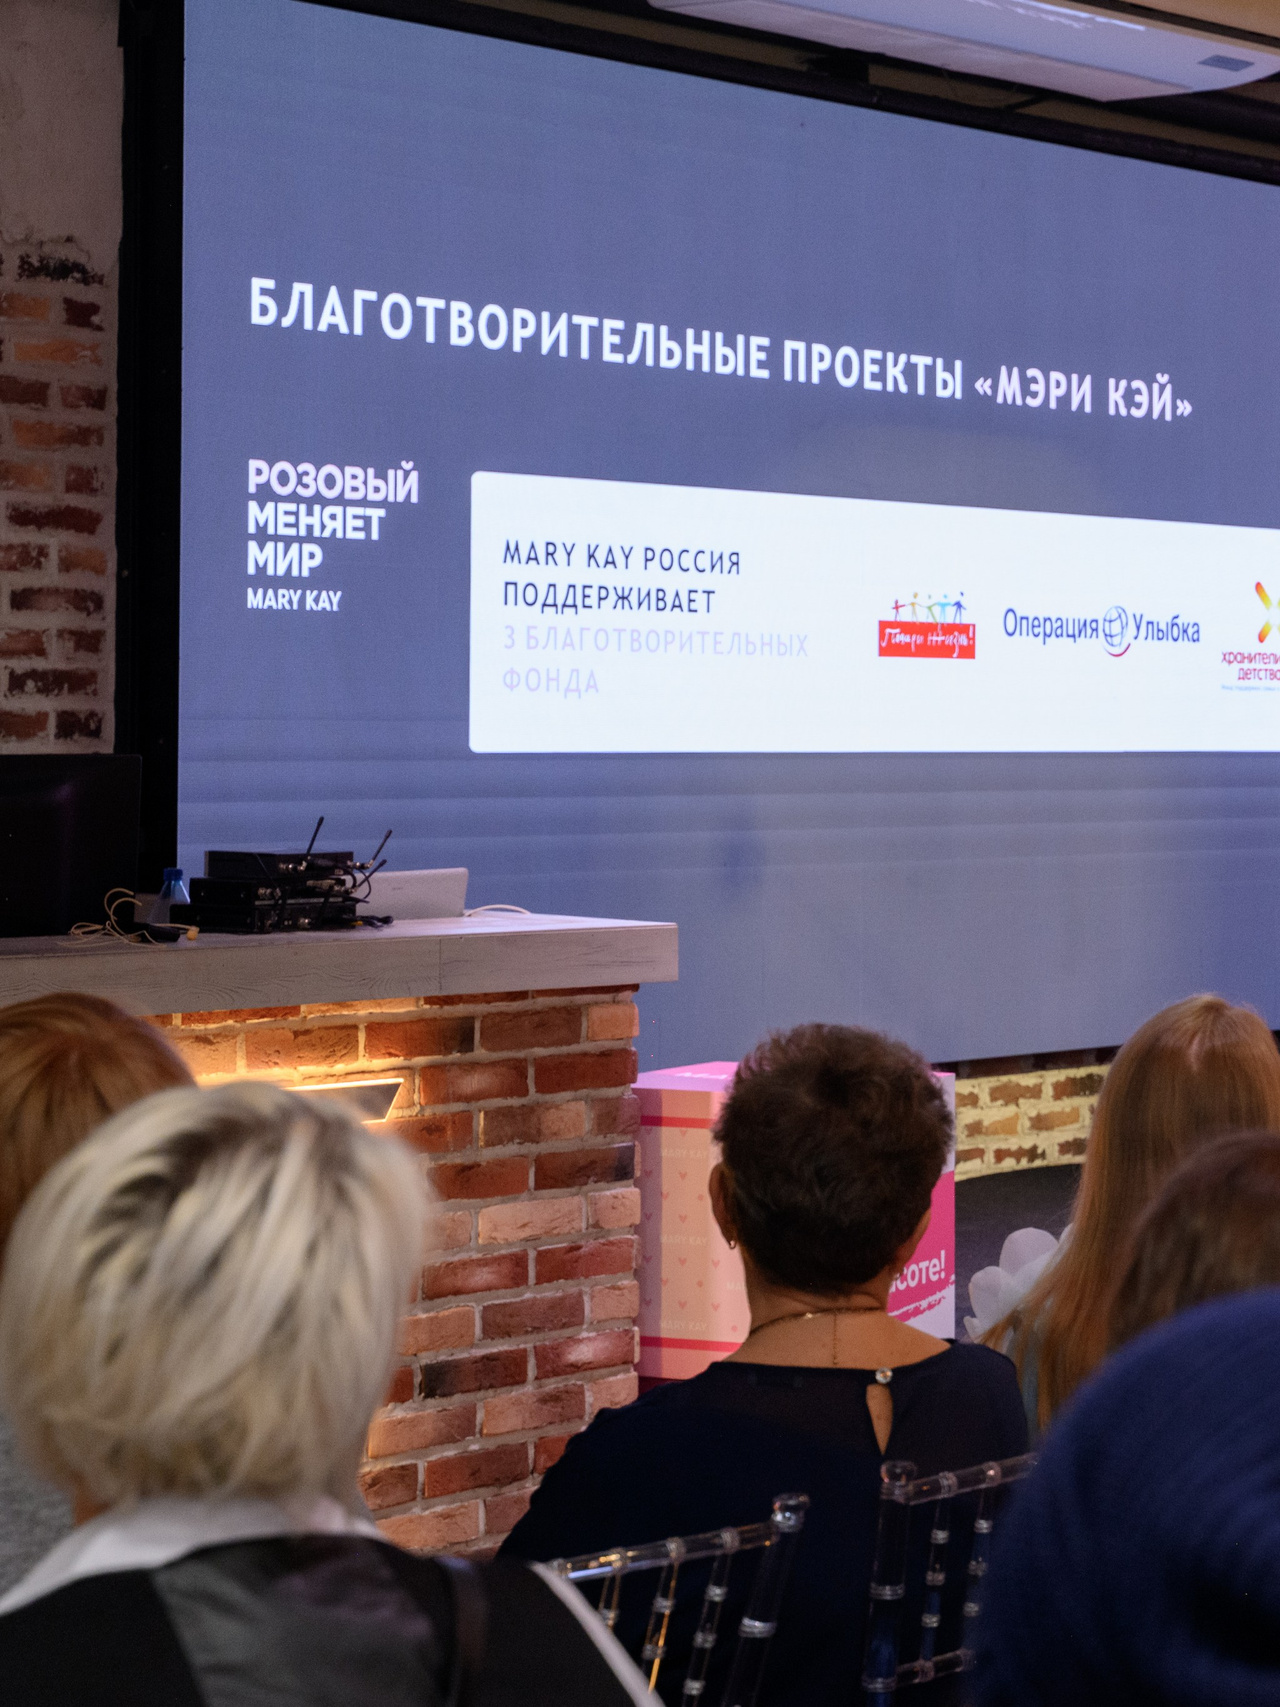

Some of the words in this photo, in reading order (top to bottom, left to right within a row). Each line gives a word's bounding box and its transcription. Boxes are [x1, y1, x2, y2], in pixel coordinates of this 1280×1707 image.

[250, 276, 772, 381] БЛАГОТВОРИТЕЛЬНЫЕ
[783, 340, 964, 401] ПРОЕКТЫ
[974, 365, 1094, 414] «МЭРИ
[1108, 373, 1194, 422] КЭЙ»
[248, 459, 420, 505] РОЗОВЫЙ
[248, 502, 386, 540] МЕНЯЕТ
[247, 541, 323, 578] МИР
[503, 540, 577, 568] MARY
[587, 544, 635, 572] KAY
[643, 547, 741, 576] РОССИЯ
[247, 588, 303, 612] MARY
[305, 590, 343, 613] KAY
[504, 582, 717, 616] ПОДДЕРЖИВАЕТ
[504, 626, 517, 650] 3
[525, 626, 810, 658] БЛАГОТВОРИТЕЛЬНЫХ
[1003, 608, 1100, 645] Операция
[1131, 613, 1201, 645] Улыбка
[503, 667, 600, 700] ФОНДА
